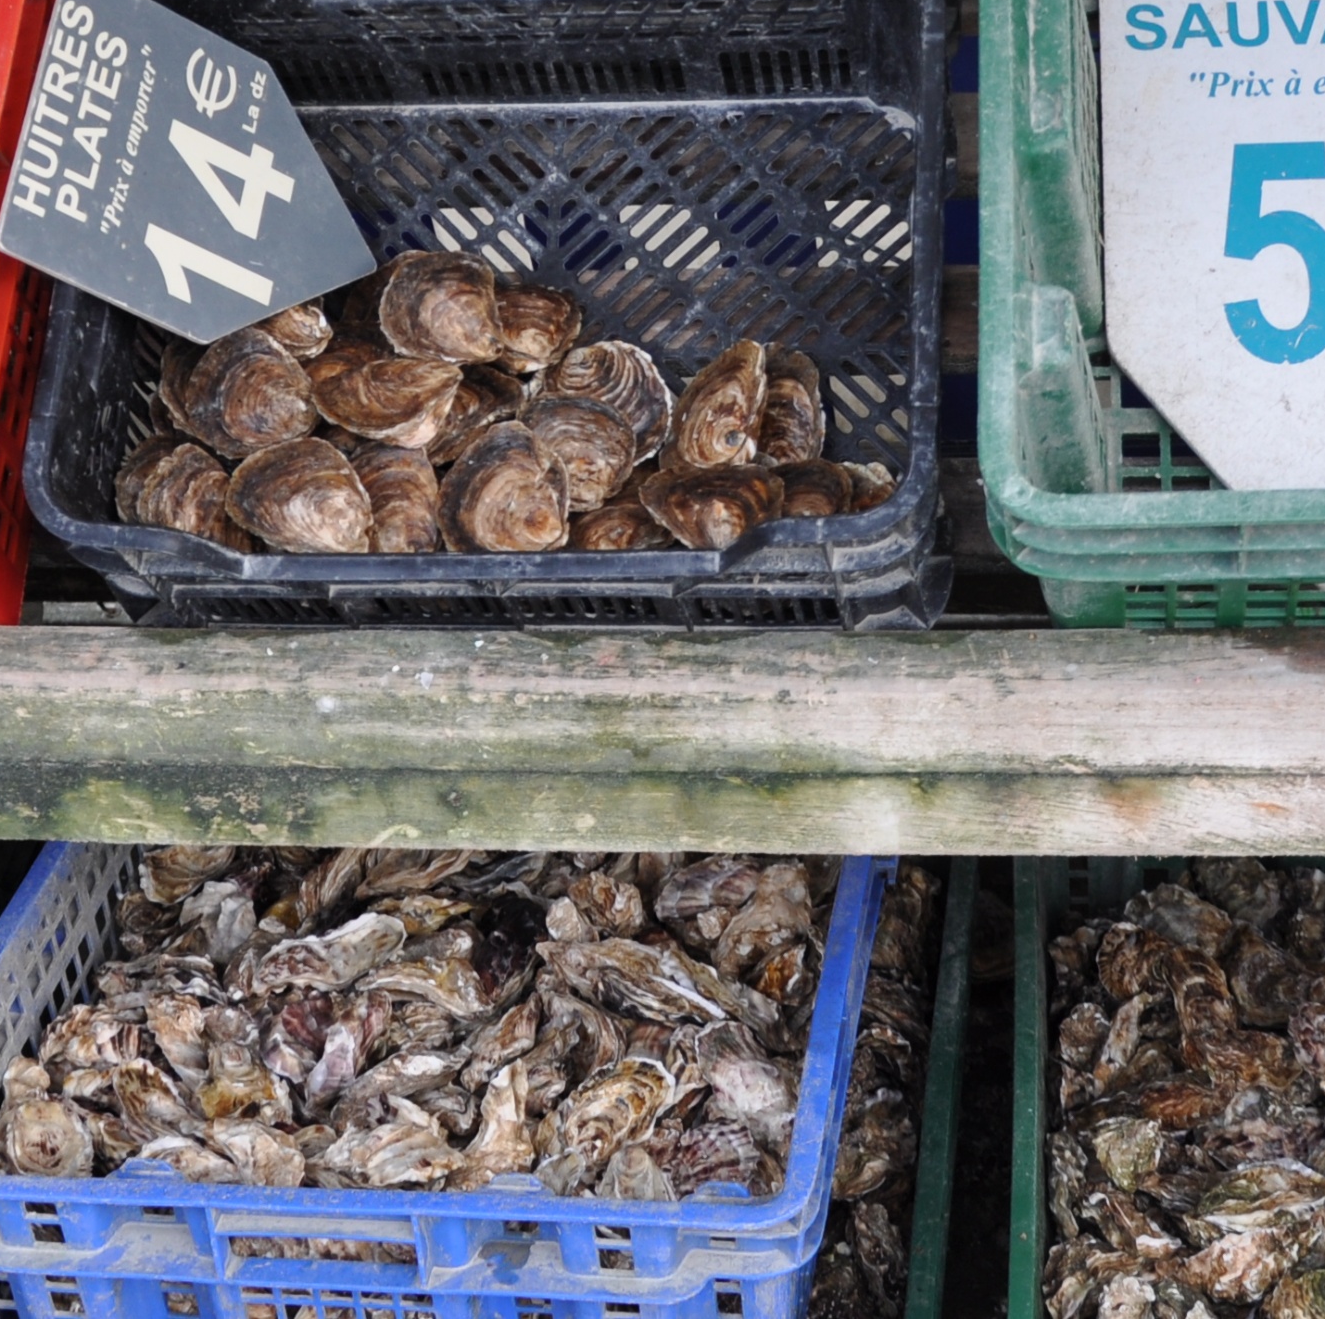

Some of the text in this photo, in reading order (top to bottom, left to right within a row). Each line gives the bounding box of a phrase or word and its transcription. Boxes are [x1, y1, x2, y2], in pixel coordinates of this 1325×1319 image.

[13, 0, 94, 218] HUITRES
[242, 70, 267, 134] La dz
[1284, 69, 1301, 96] à
[55, 31, 128, 223] PLATES
[116, 158, 134, 175] à
